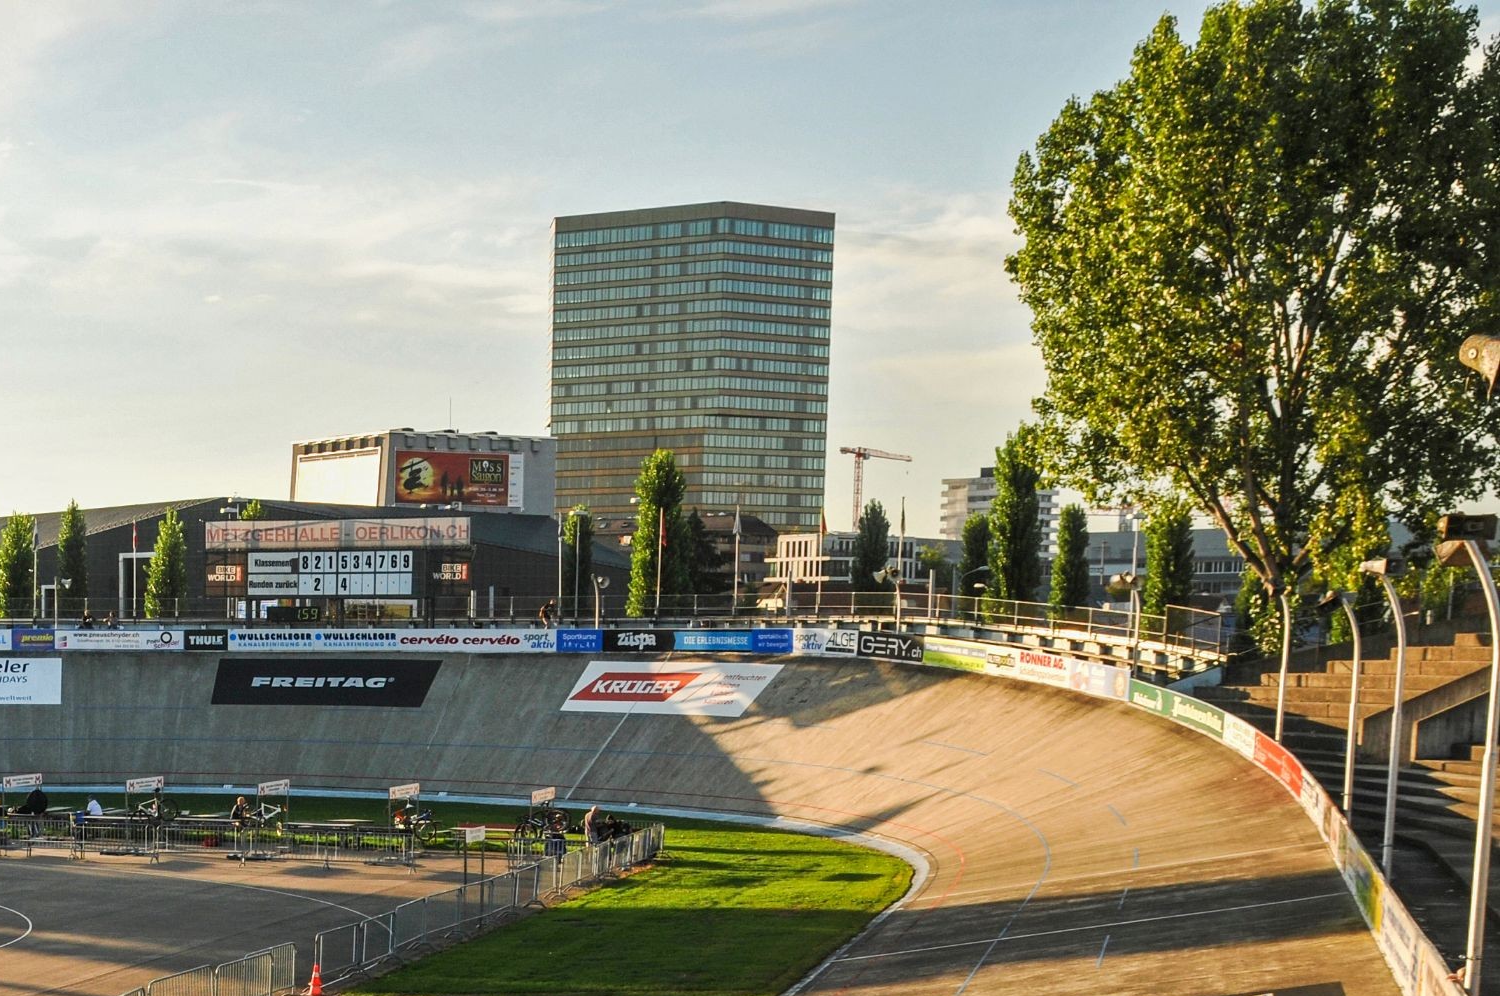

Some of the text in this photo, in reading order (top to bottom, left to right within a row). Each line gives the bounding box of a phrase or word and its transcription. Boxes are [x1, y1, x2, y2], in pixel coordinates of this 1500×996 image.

[471, 472, 502, 482] Saigon
[207, 527, 340, 542] METZGERHALLE
[356, 524, 469, 540] OERLIKON.CH
[254, 555, 410, 570] Klassement 8 2 1 5 3 4 7 6 9
[442, 564, 461, 572] BIKE
[433, 572, 461, 580] WORLD
[314, 578, 320, 591] 2
[341, 578, 347, 591] 4
[189, 635, 223, 645] THULE
[400, 634, 458, 645] cervélo
[463, 635, 520, 645] cervélo
[524, 633, 548, 642] sport
[684, 636, 748, 645] DIE ERLEBNISMESSE
[795, 633, 818, 642] sport
[826, 633, 855, 646] ALGE
[531, 639, 555, 648] aktiv
[802, 640, 822, 650] aktiv
[861, 635, 922, 658] GERY.ch
[1020, 652, 1052, 668] RONNER
